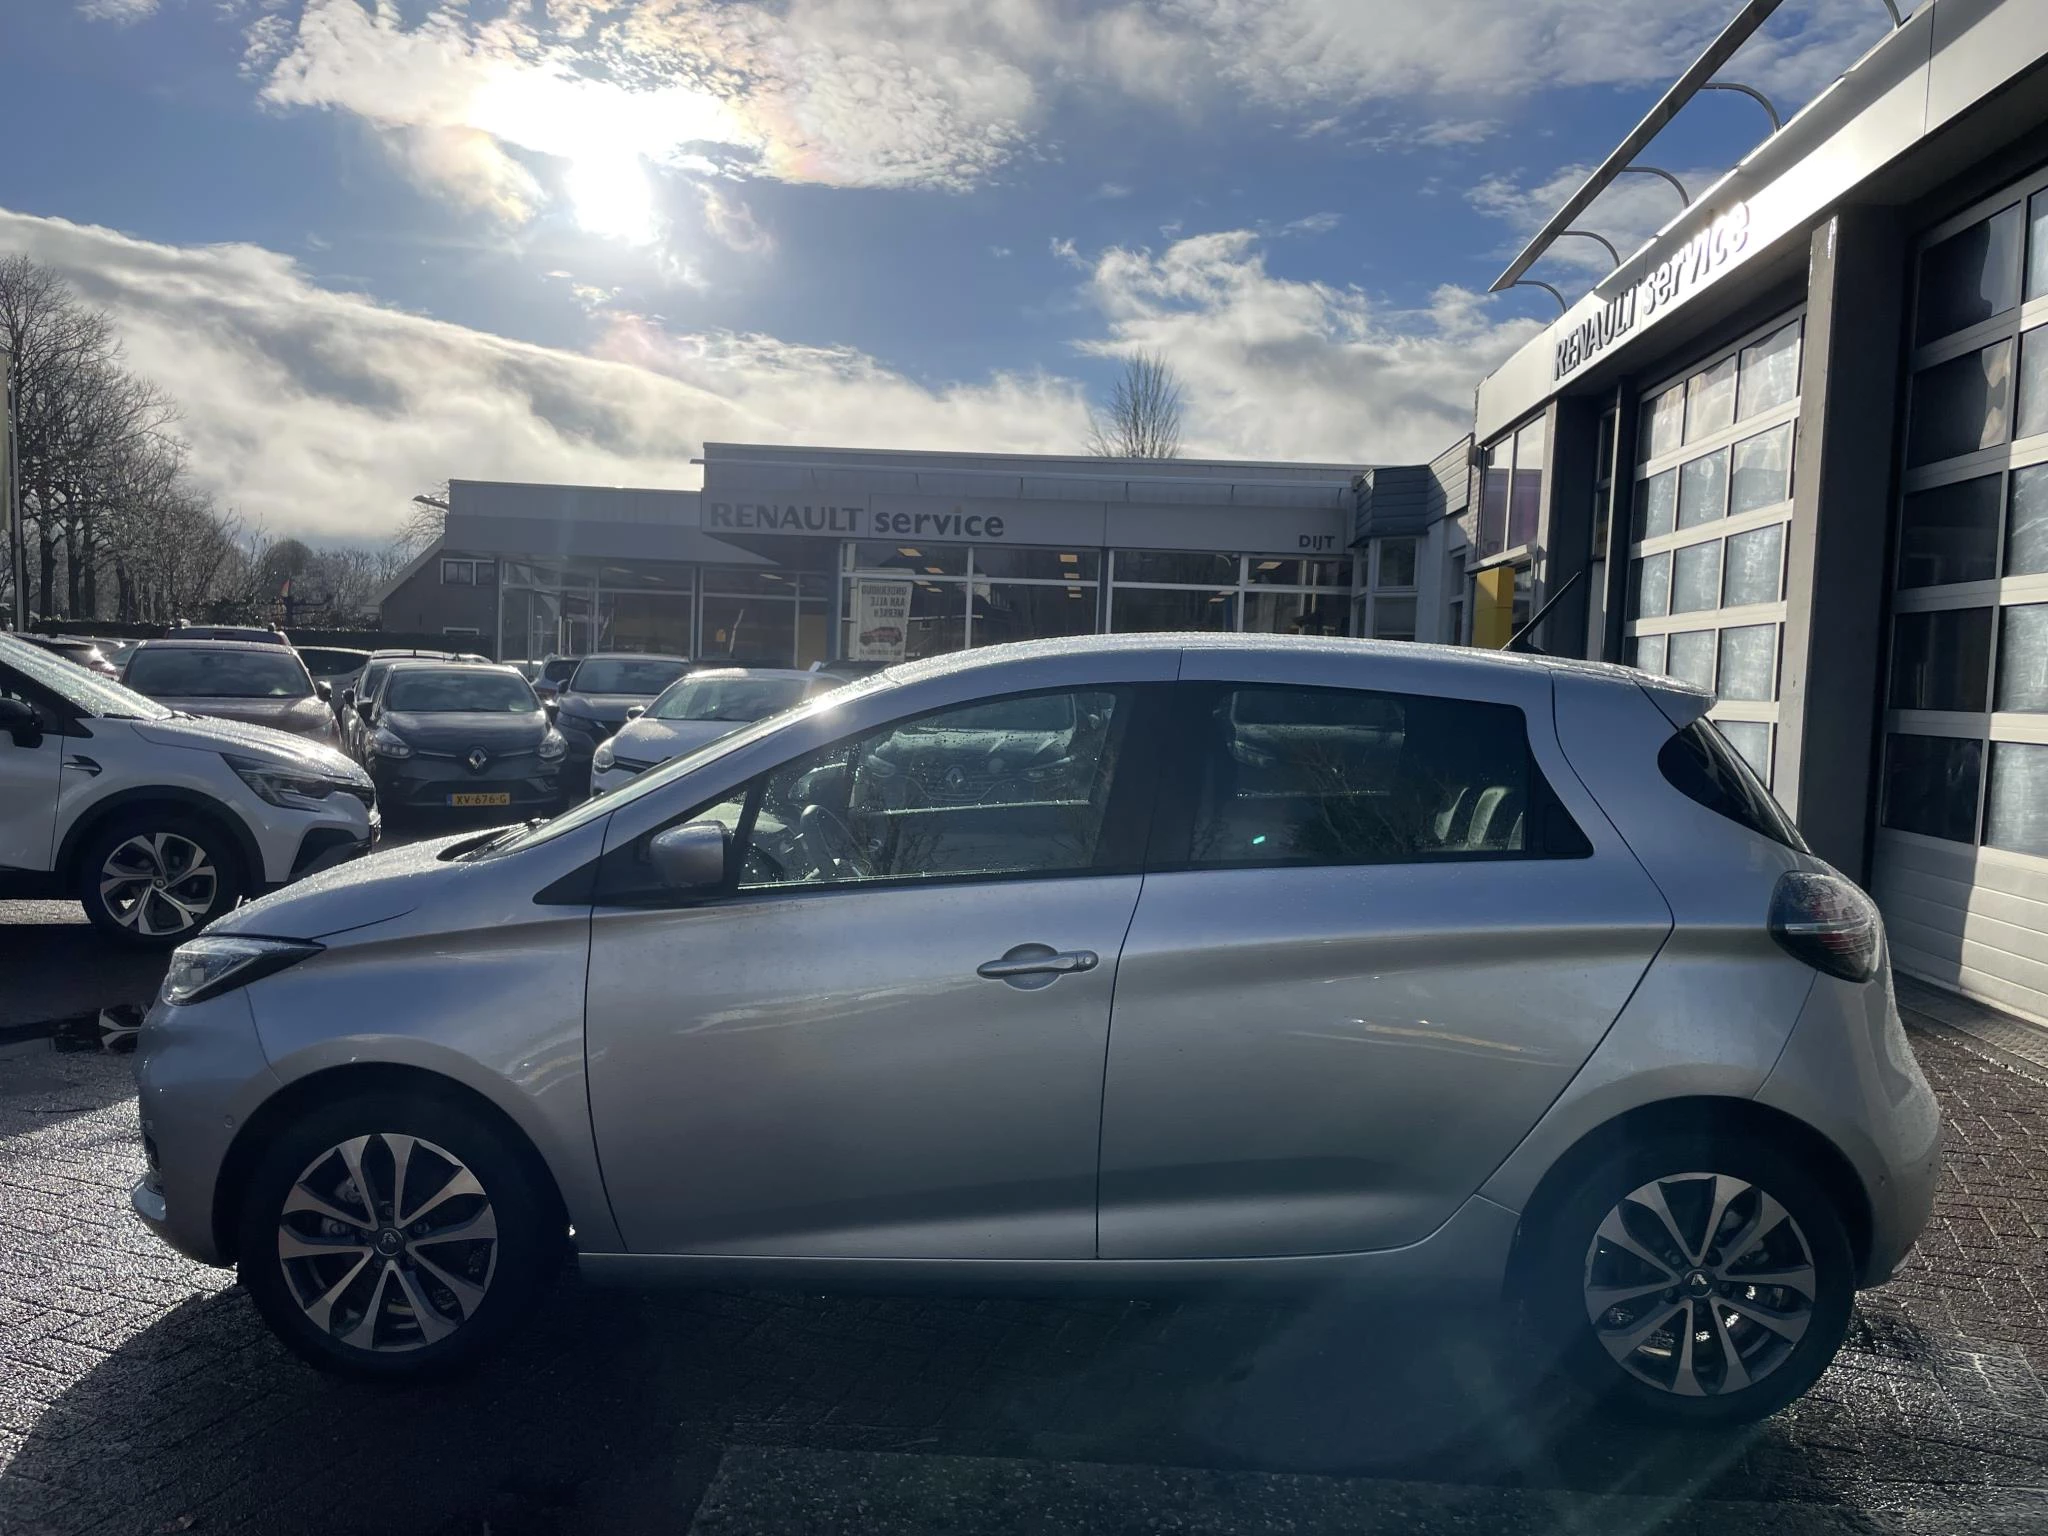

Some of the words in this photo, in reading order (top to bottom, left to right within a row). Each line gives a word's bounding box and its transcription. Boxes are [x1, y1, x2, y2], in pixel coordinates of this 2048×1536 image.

[1553, 278, 1642, 381] RENAULT
[1643, 202, 1749, 315] service
[709, 502, 864, 532] RENAULT
[875, 507, 1004, 537] service
